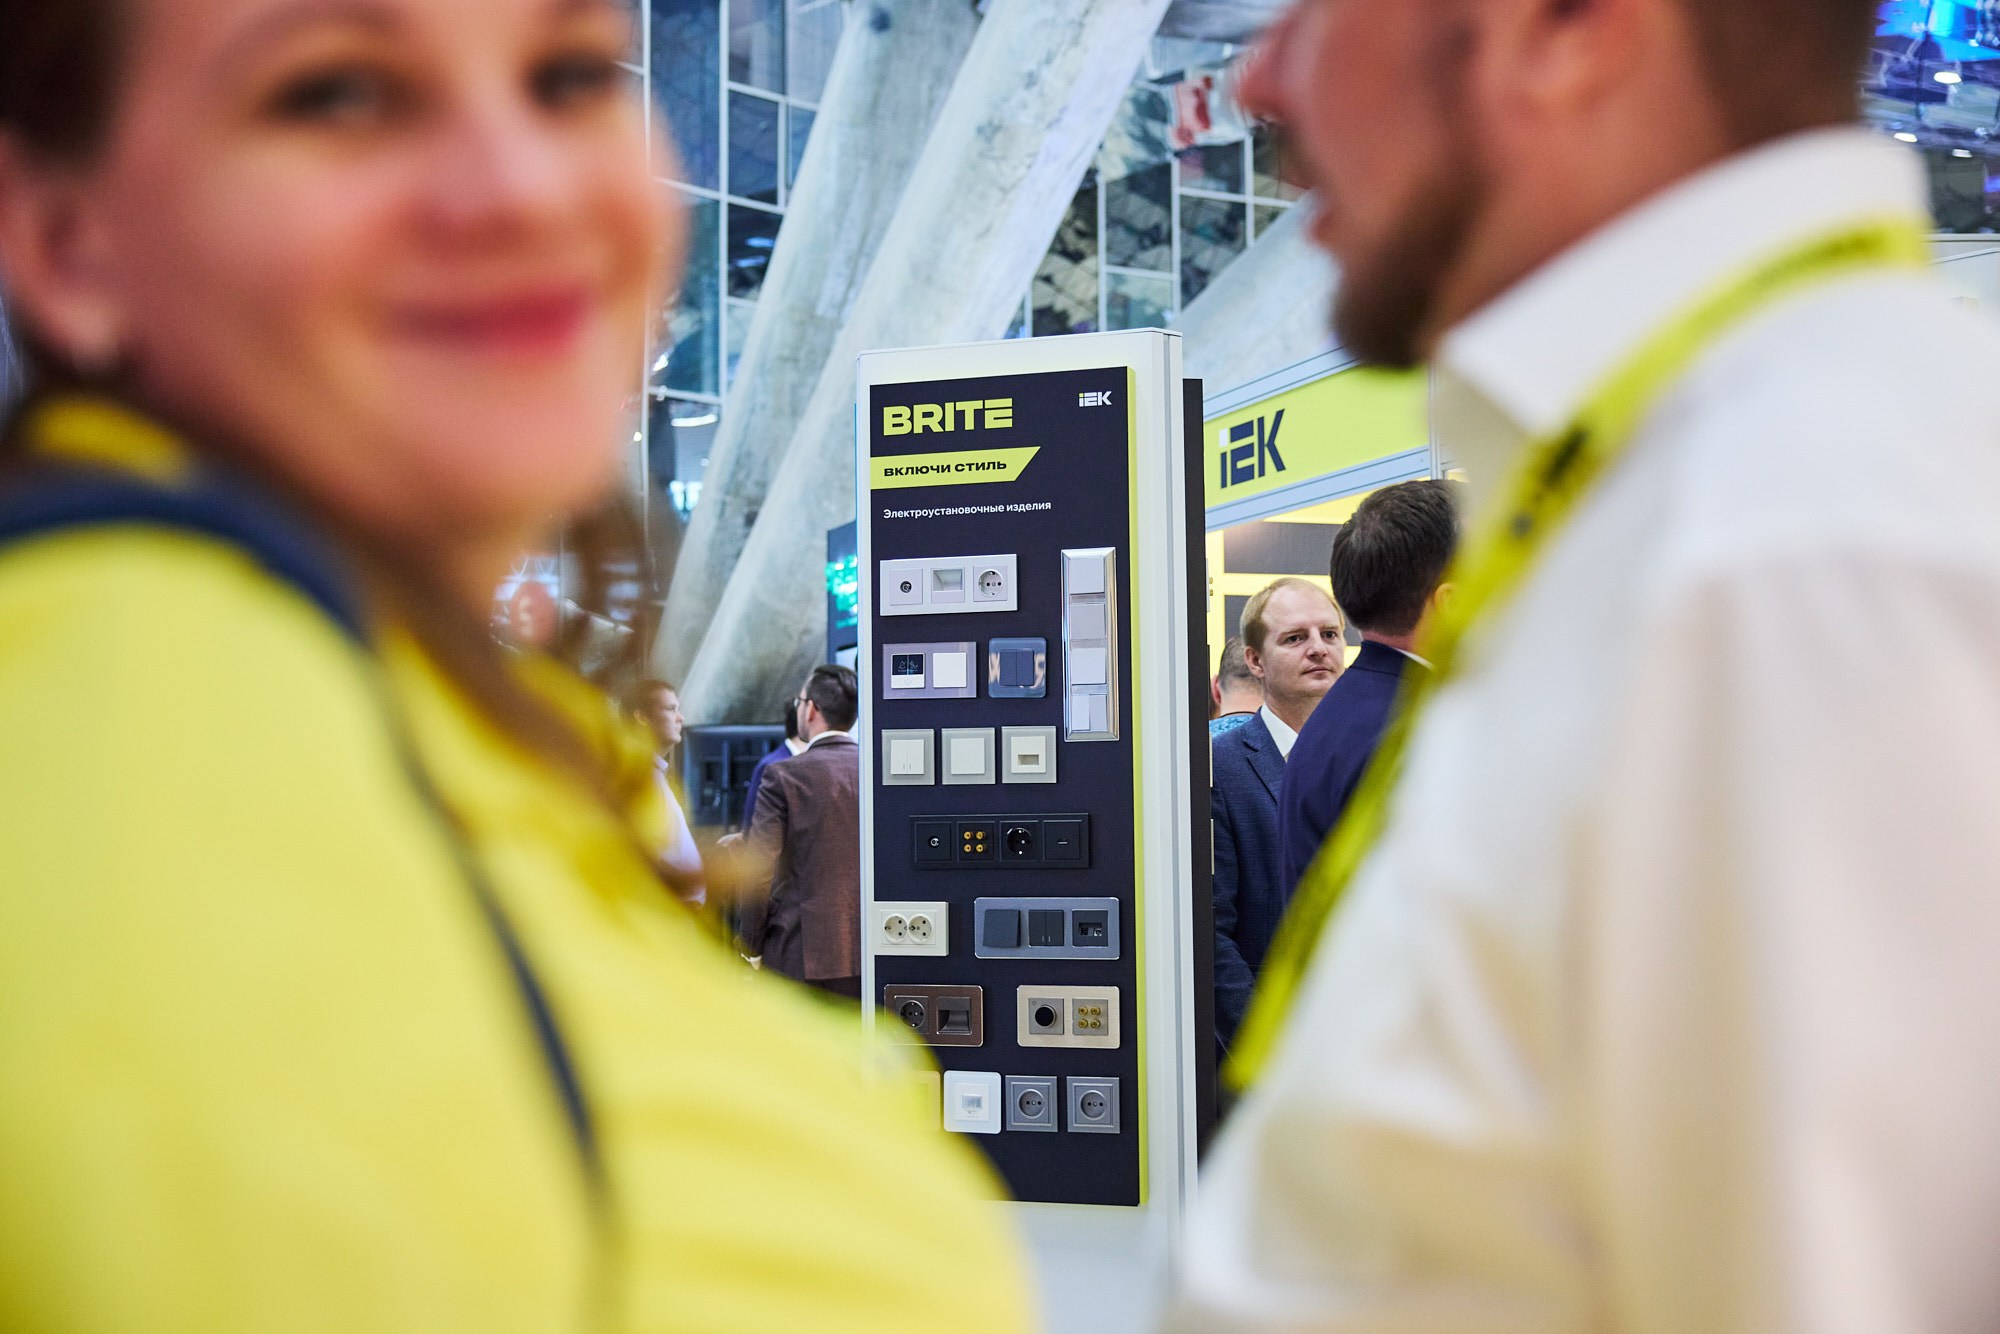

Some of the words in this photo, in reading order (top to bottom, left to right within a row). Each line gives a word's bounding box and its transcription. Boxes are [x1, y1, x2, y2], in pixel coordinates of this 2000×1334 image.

[883, 398, 1013, 436] BRITE
[883, 504, 1005, 519] Электроустановочные
[1006, 502, 1052, 514] изделия
